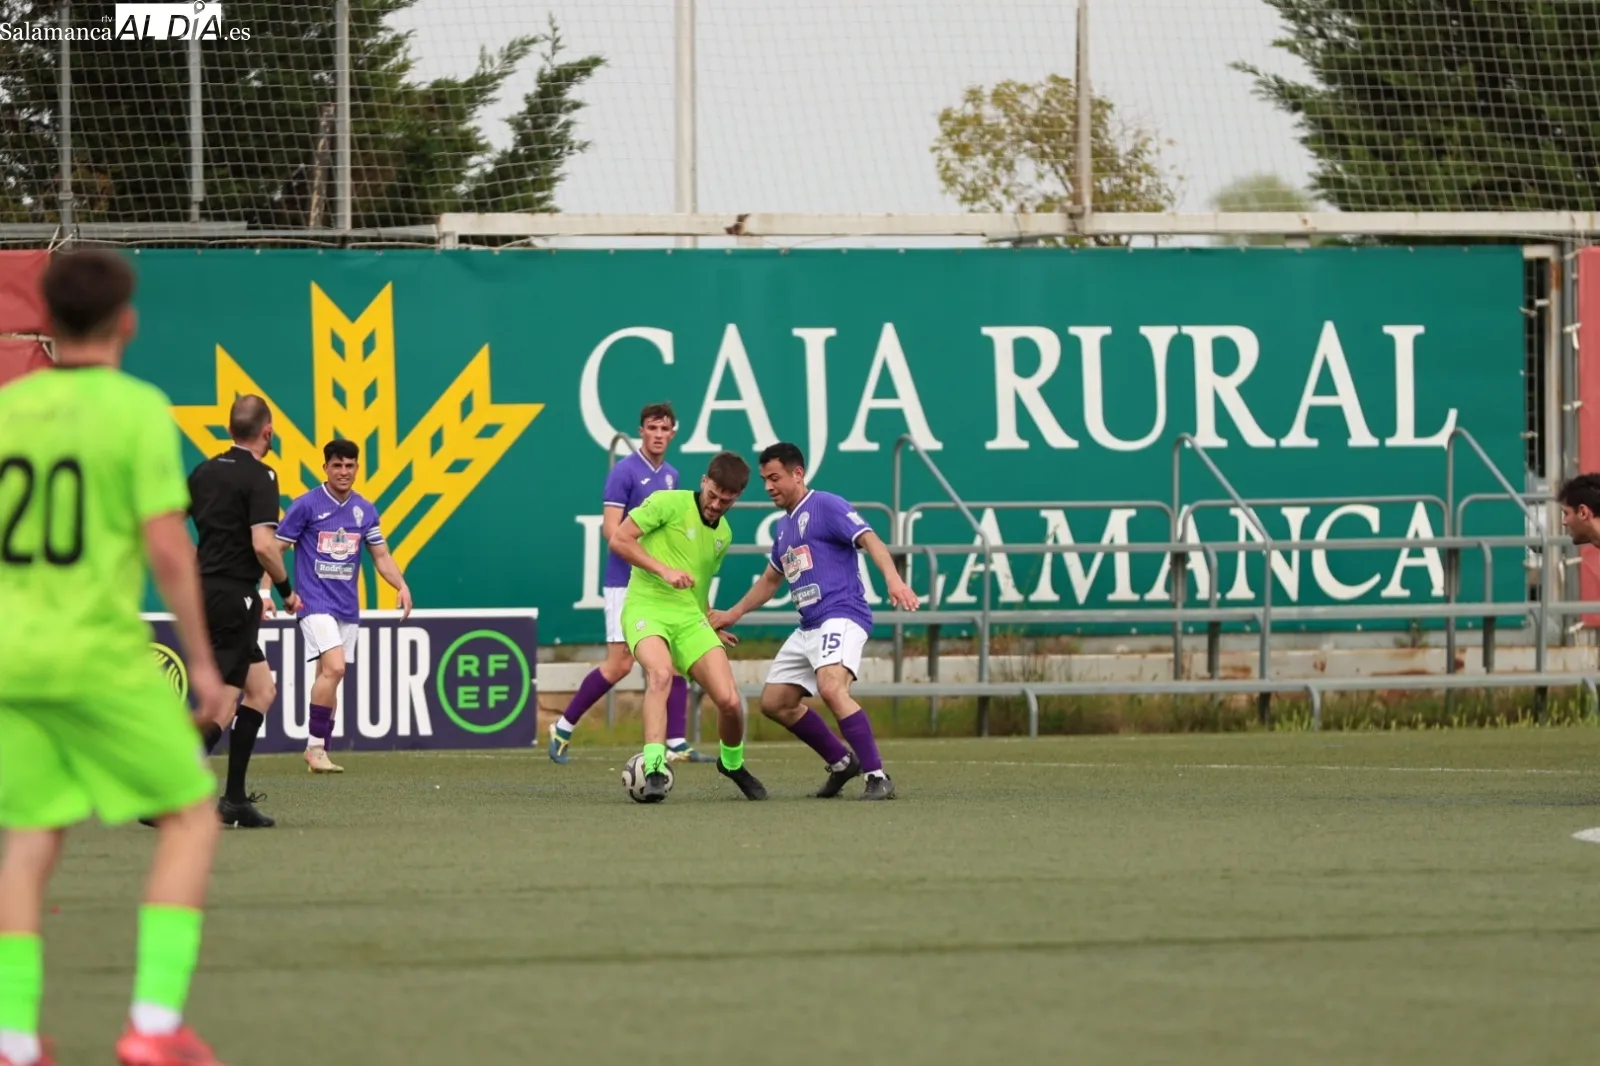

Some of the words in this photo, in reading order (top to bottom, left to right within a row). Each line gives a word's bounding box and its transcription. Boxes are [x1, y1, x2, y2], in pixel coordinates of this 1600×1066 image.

[579, 322, 943, 483] CAJA
[981, 320, 1458, 451] RURAL
[0, 456, 84, 566] 20
[822, 632, 841, 651] 15
[458, 654, 509, 678] RF
[458, 685, 510, 709] EF
